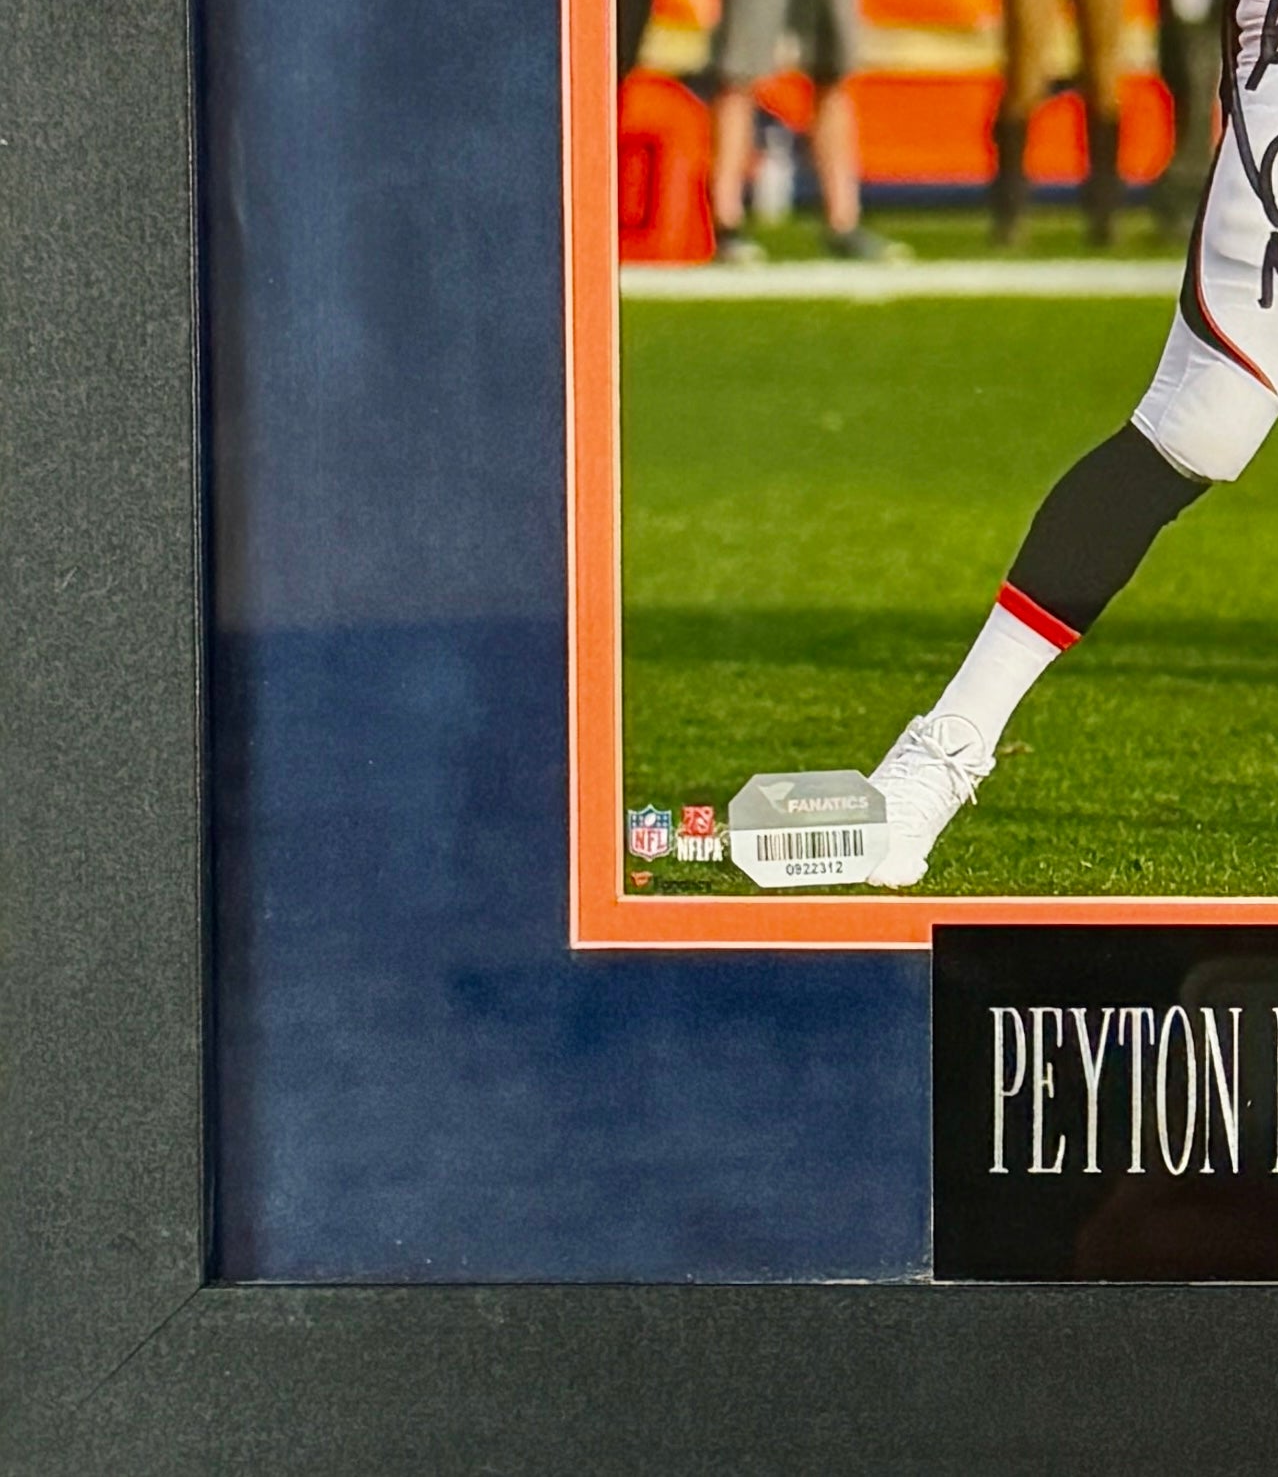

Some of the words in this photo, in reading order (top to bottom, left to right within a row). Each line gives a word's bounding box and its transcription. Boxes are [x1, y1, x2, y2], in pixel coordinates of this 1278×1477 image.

[787, 796, 869, 814] FANATICS
[633, 829, 668, 853] NFL
[677, 835, 723, 862] NFLPA
[988, 1005, 1243, 1175] PEYTON
